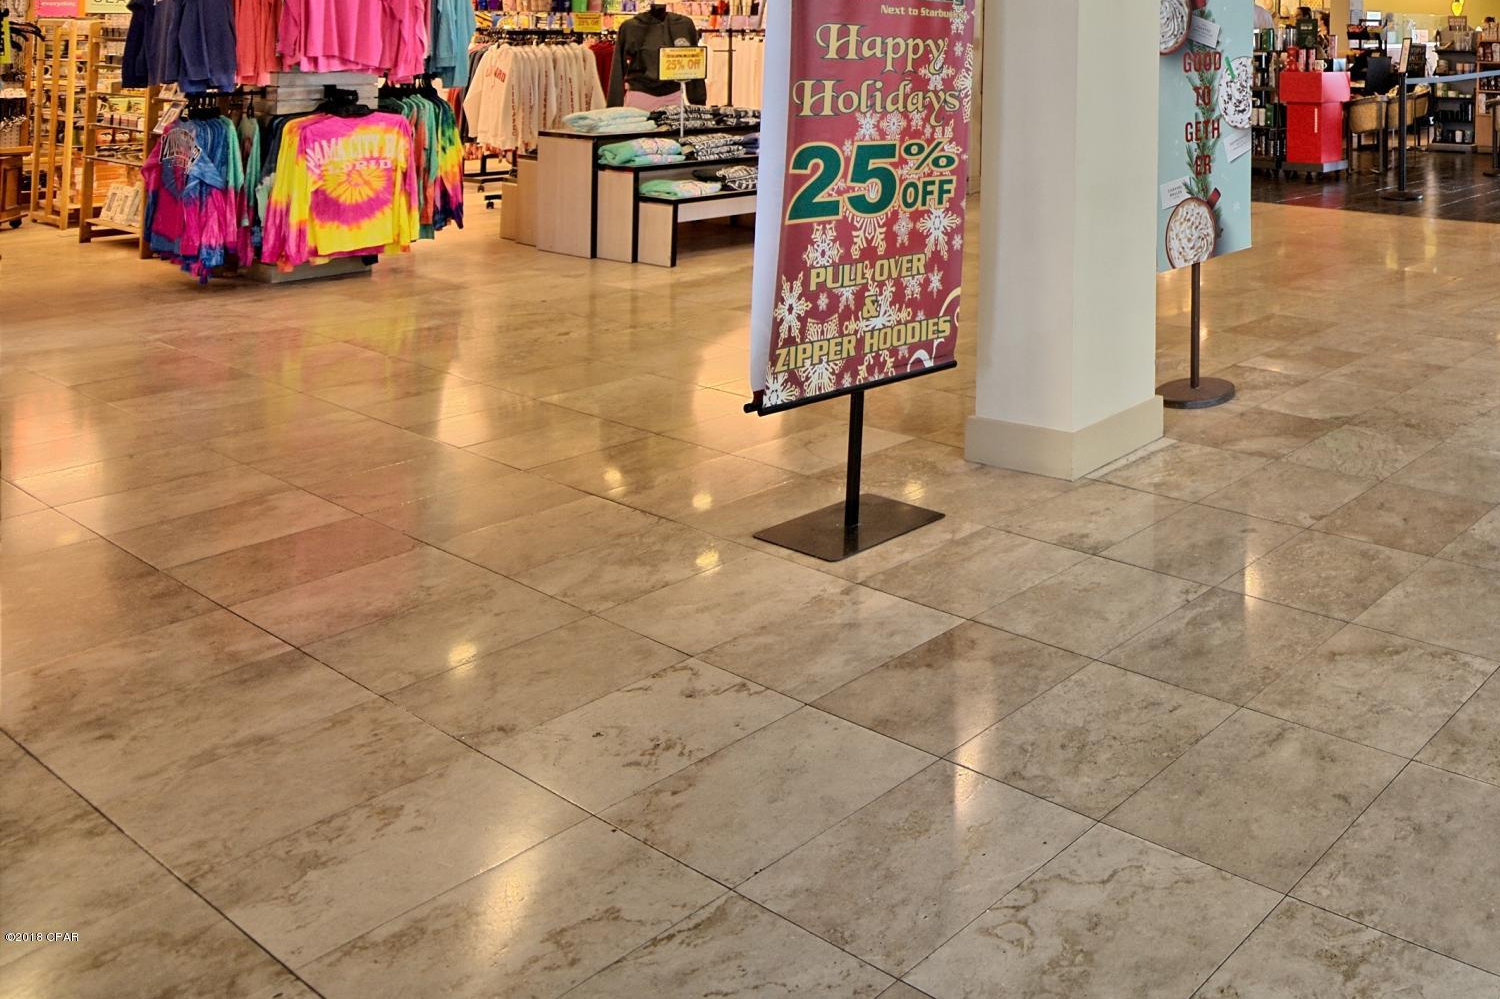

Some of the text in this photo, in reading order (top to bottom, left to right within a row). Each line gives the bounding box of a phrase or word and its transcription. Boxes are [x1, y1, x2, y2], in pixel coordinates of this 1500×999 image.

[880, 4, 905, 15] Next
[908, 7, 919, 15] to
[815, 23, 949, 75] Happy
[1183, 51, 1222, 73] GOOD
[792, 79, 961, 127] Holidays
[1193, 85, 1211, 106] TO
[1184, 118, 1220, 143] GETH
[1194, 154, 1212, 177] ER
[785, 138, 959, 225] 25% OFF
[809, 252, 927, 291] PULL OVER
[861, 295, 881, 320] &
[774, 315, 951, 374] ZIPPER HOODIES
